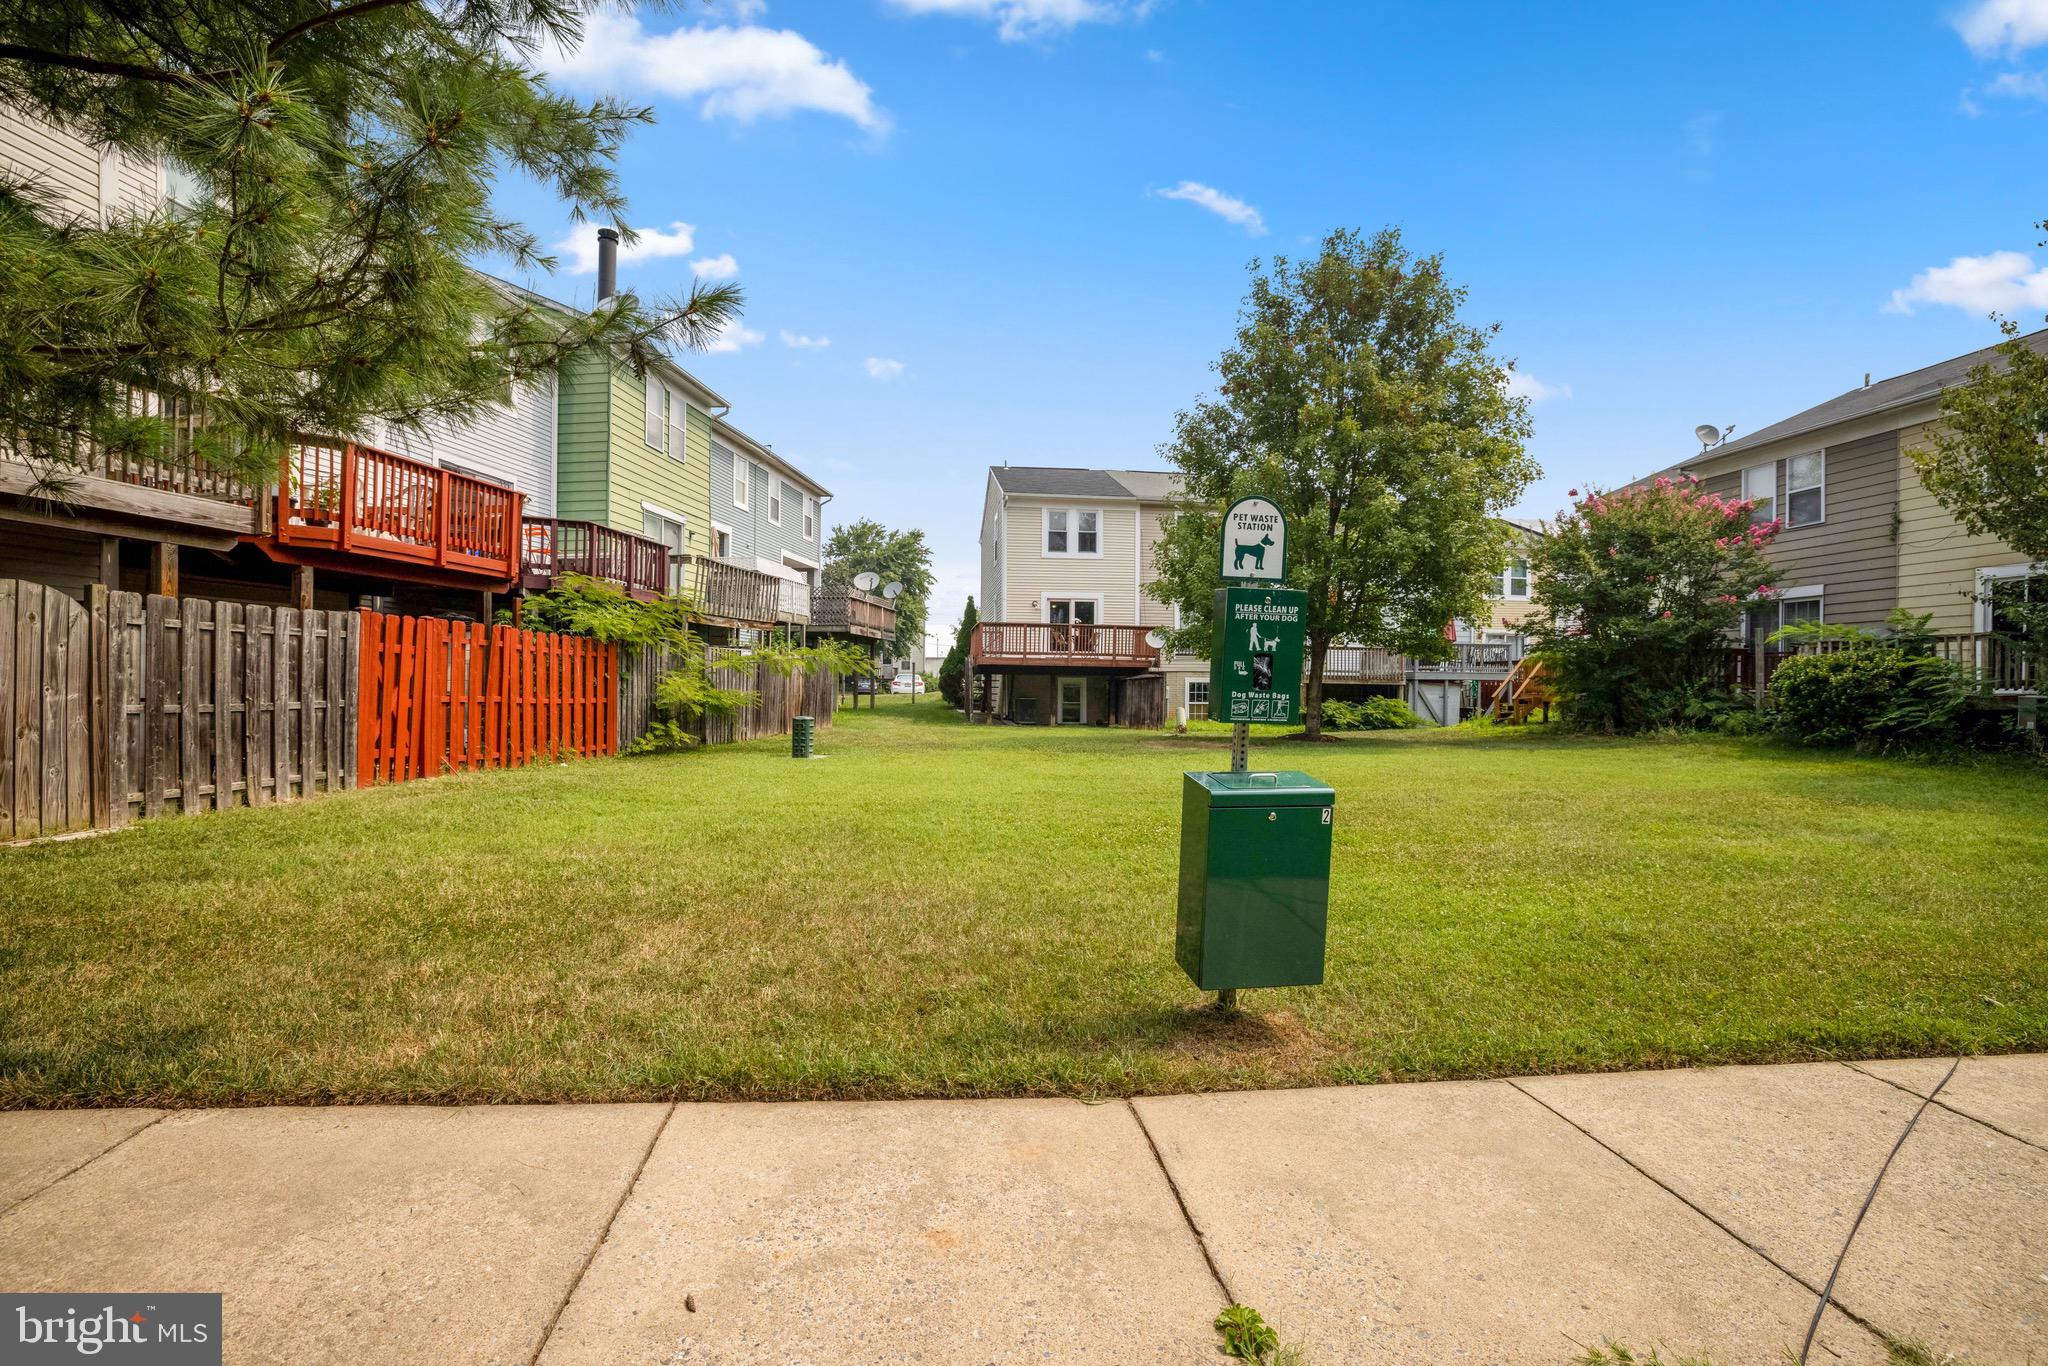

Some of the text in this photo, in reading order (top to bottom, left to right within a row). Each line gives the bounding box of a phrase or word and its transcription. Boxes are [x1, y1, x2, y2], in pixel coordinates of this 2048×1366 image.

[1233, 513, 1279, 523] PET WASTE
[1237, 522, 1273, 531] STATION
[1235, 604, 1299, 614] PLEASE CLEAN UP
[1232, 691, 1246, 699] Dog
[1322, 809, 1330, 823] 2
